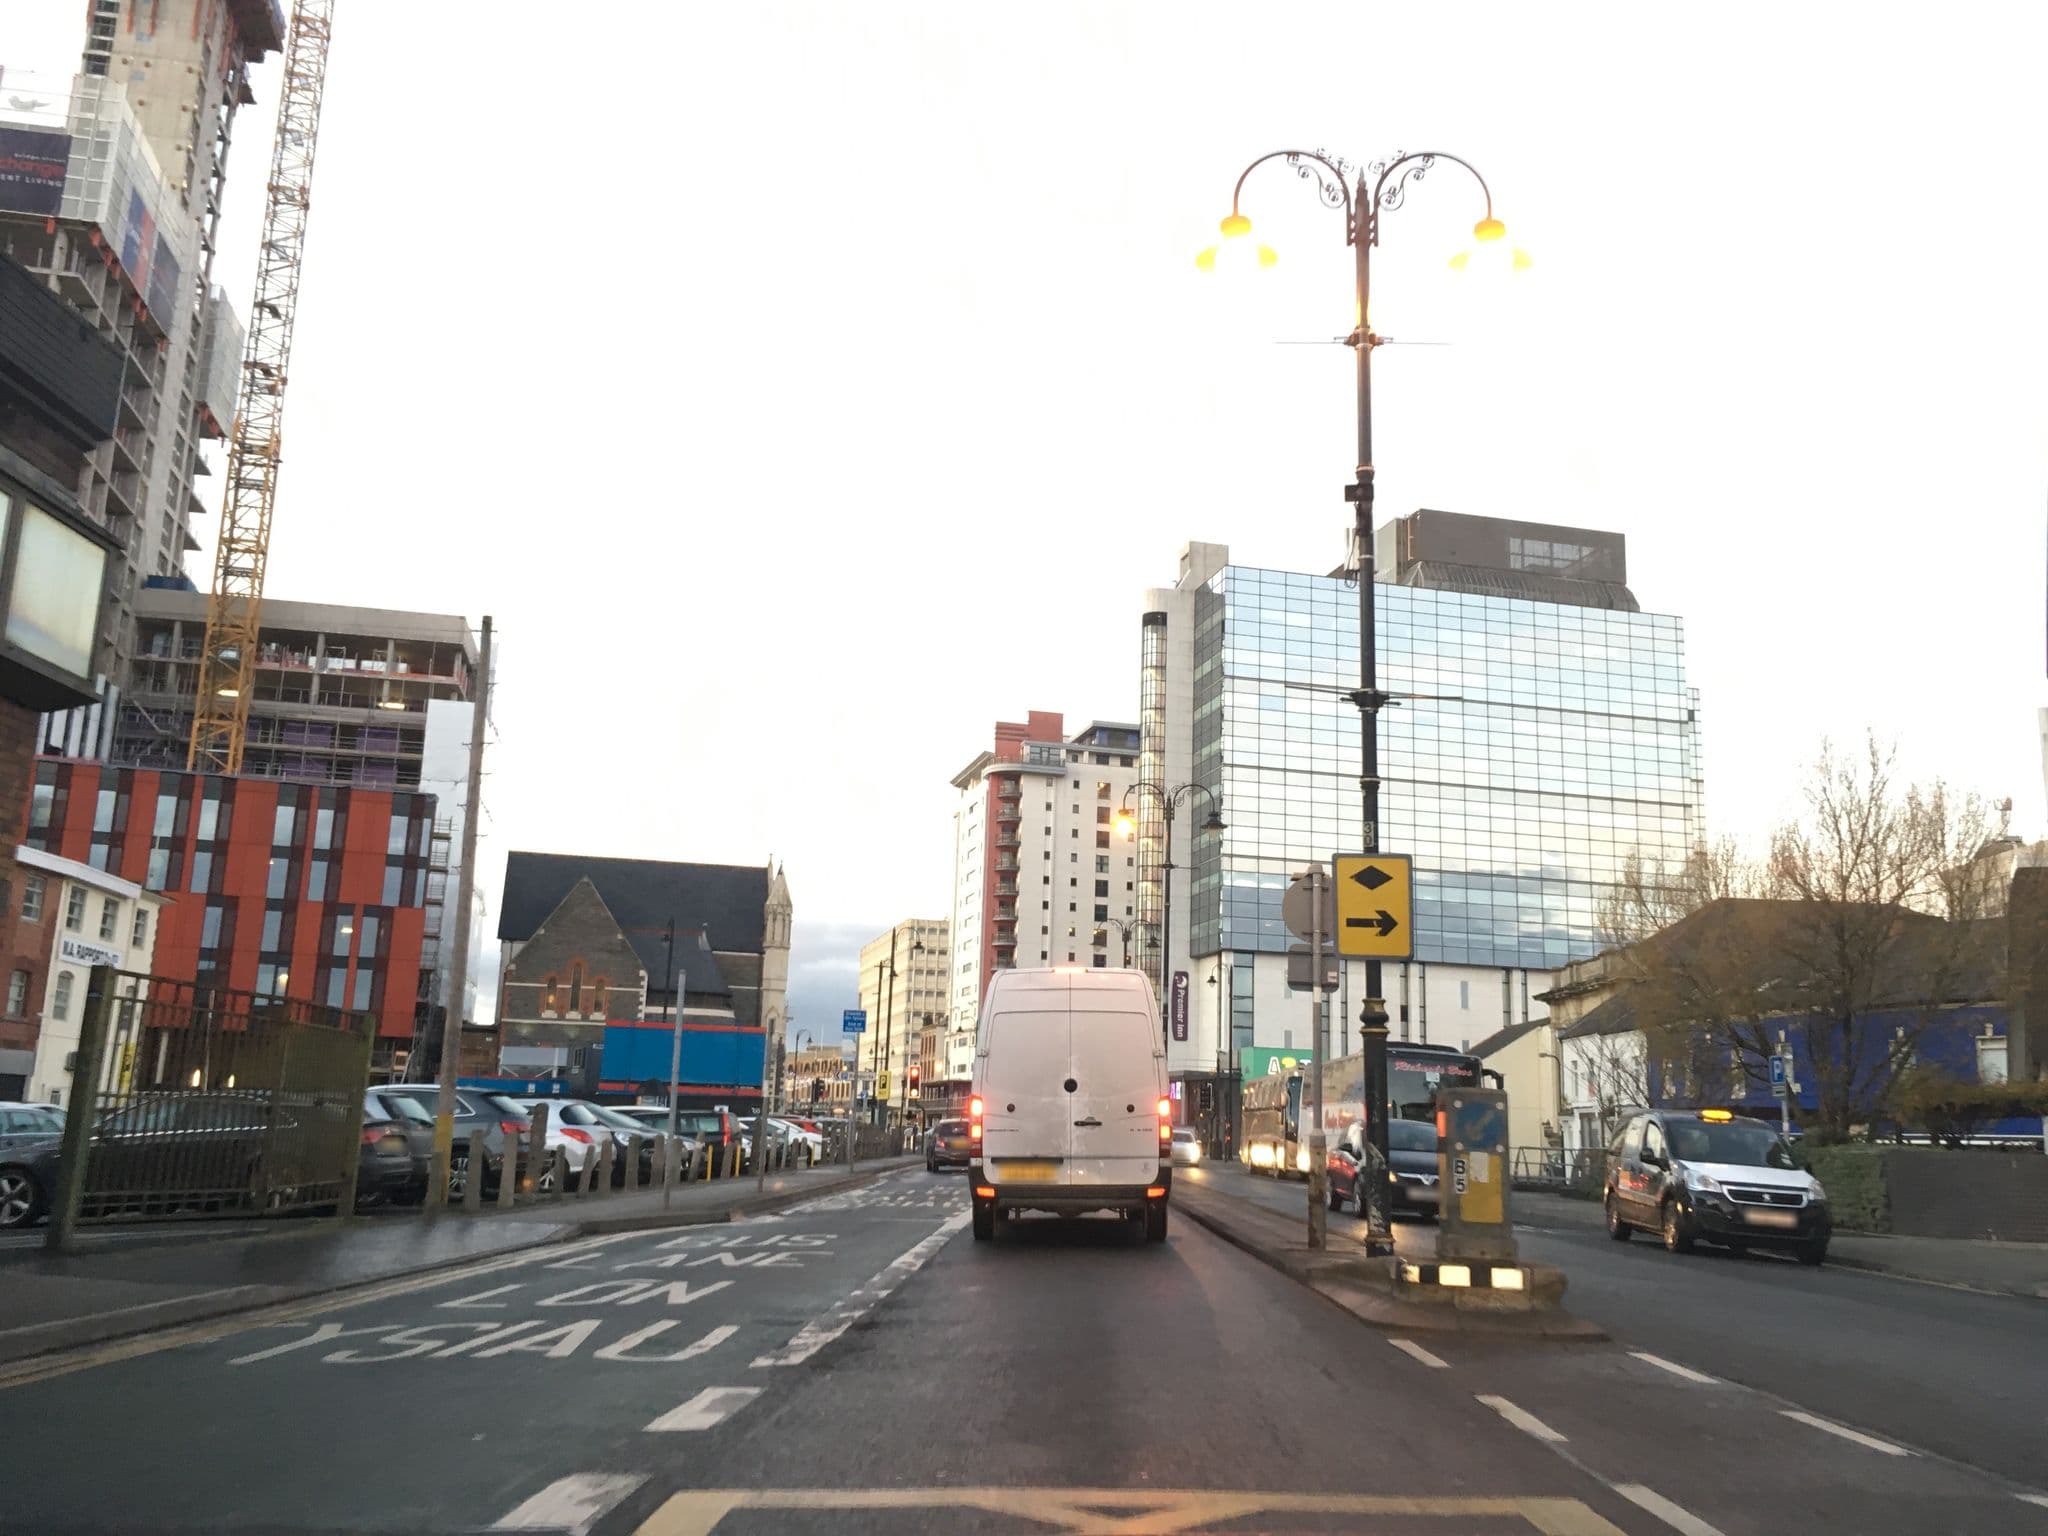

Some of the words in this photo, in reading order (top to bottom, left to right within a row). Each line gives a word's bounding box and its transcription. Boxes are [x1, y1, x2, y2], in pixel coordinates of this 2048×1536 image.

[1177, 988, 1186, 1023] Premier
[1177, 1023, 1185, 1038] Inn
[654, 1234, 838, 1249] BUS
[543, 1251, 835, 1272] LANE
[436, 1279, 736, 1309] LON
